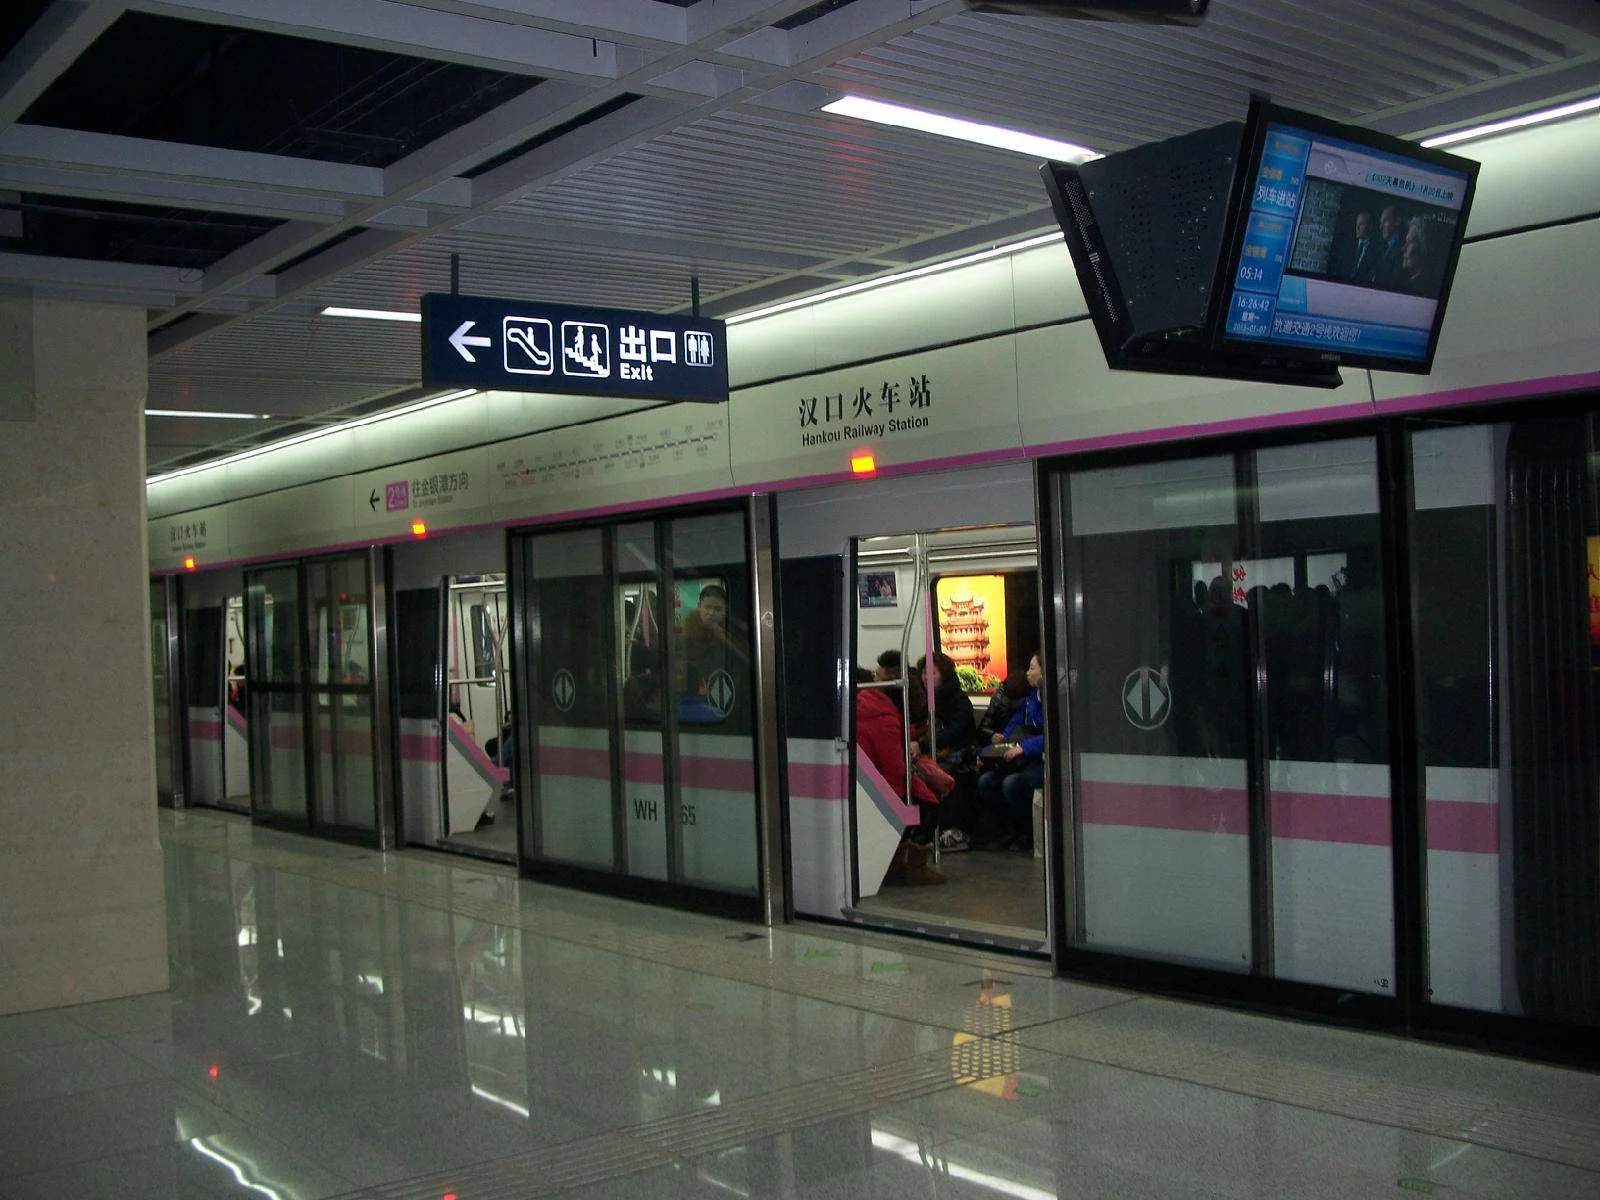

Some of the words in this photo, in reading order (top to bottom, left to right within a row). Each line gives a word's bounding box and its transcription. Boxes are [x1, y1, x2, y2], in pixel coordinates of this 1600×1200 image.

[1256, 184, 1296, 209] 列车进站
[1240, 266, 1263, 281] 05:14
[1237, 296, 1270, 311] 16:26:42
[619, 324, 677, 364] 出口
[620, 363, 654, 382] Exit
[799, 374, 931, 428] 汉口火车站
[802, 429, 841, 447] Hankou
[843, 423, 885, 440] Railway
[888, 415, 929, 432] Station
[634, 798, 658, 822] WH
